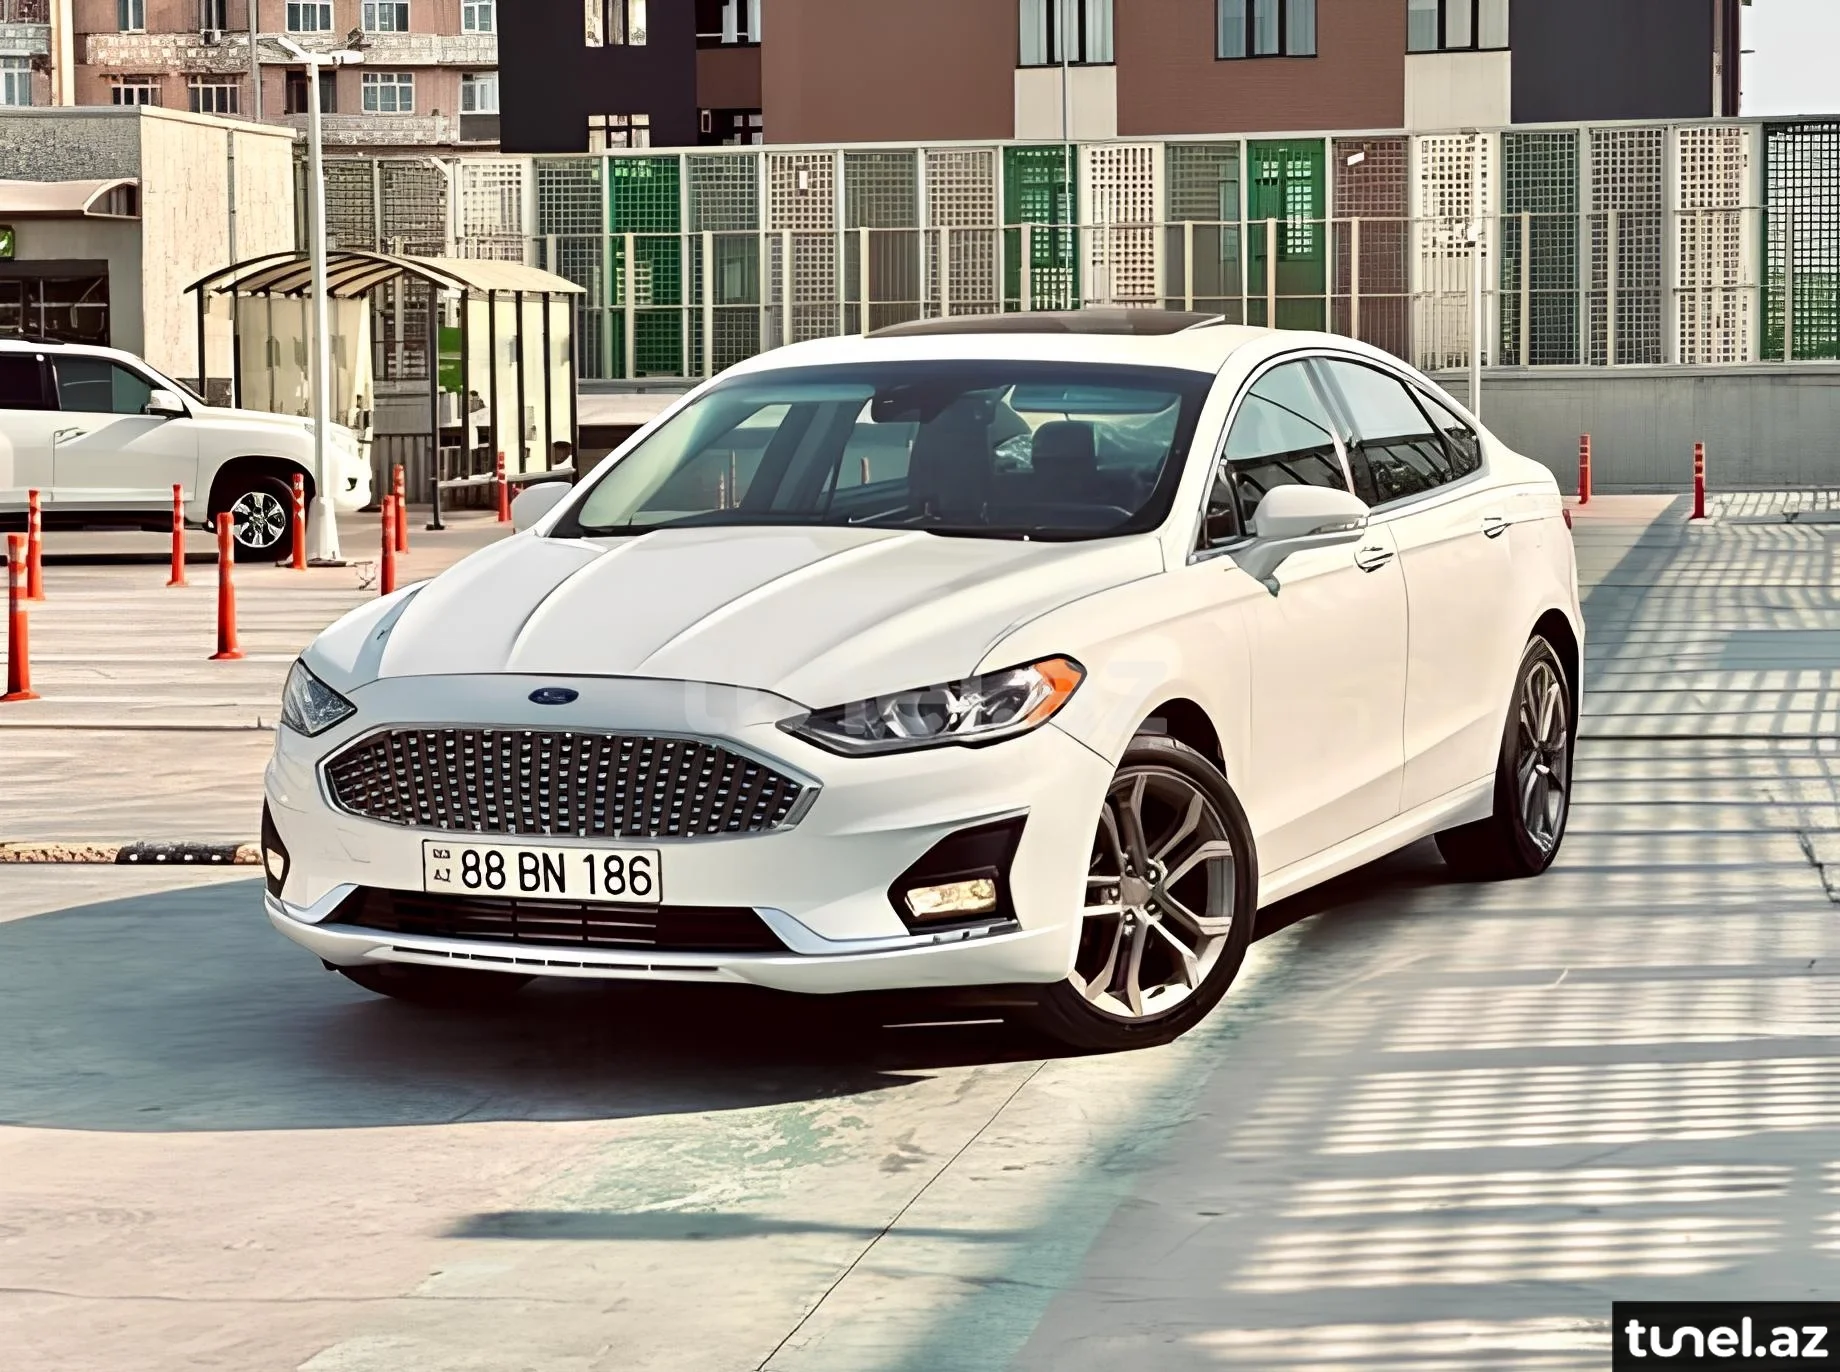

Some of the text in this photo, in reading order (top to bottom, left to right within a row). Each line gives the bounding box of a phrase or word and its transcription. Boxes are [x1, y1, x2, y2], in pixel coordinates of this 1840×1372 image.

[461, 850, 652, 895] 88 BN 186
